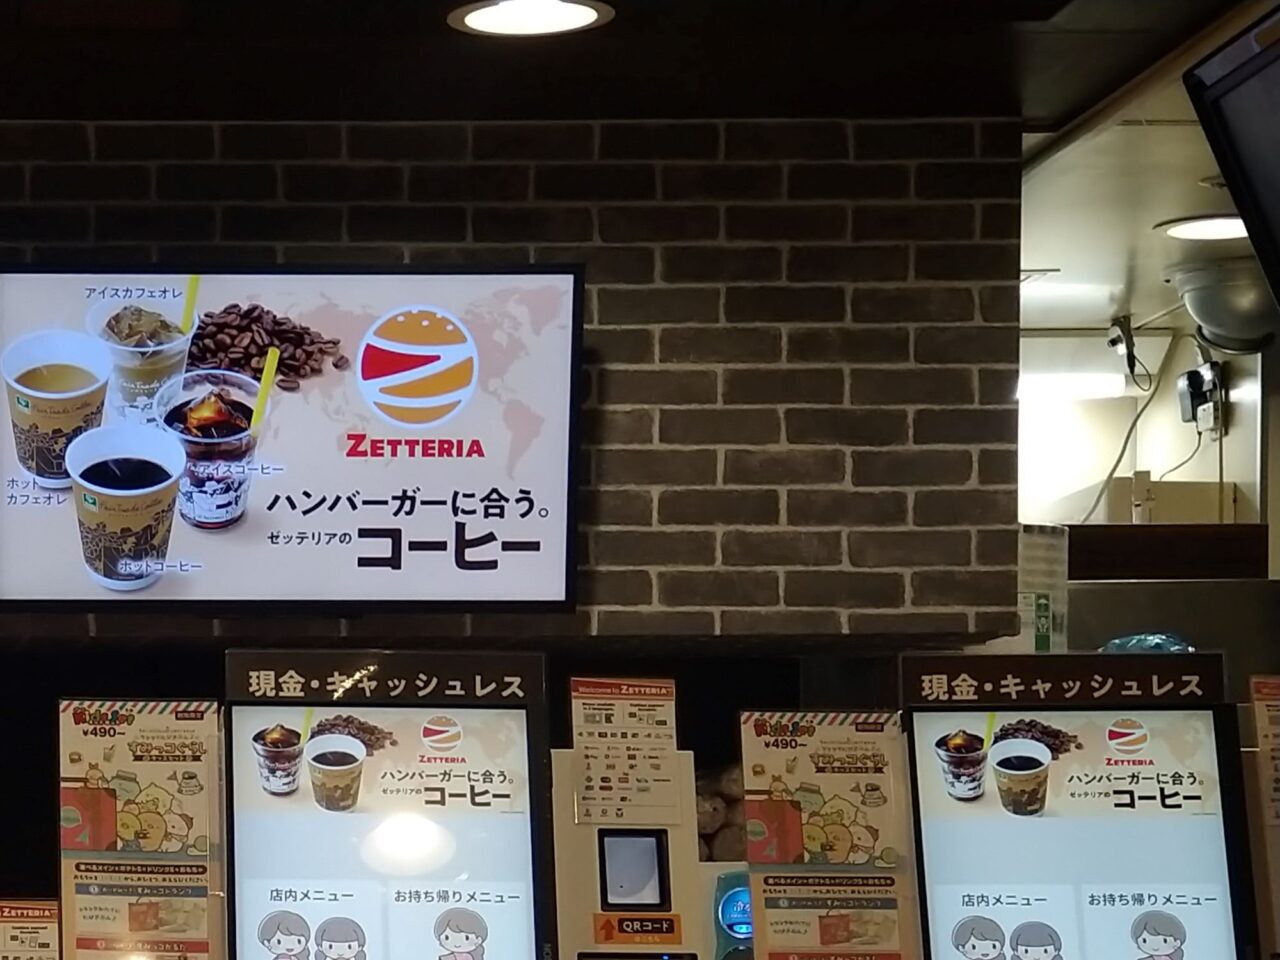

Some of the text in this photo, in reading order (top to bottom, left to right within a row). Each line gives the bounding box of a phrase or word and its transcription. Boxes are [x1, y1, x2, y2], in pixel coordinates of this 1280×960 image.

[84, 285, 183, 299] アイスカフェオレ
[345, 433, 485, 458] ZETTERIA
[198, 464, 284, 476] アイスコーヒー
[6, 477, 40, 490] ホット
[6, 493, 68, 505] カフェオレ
[267, 487, 551, 519] ハンバーガーに合う。
[267, 522, 541, 571] ゼッテリアの コーヒー
[119, 560, 203, 572] ホットコーヒー
[247, 669, 526, 698] 現金・キャッシュレス
[920, 673, 1204, 701] 現金・キャッシュレス
[418, 754, 467, 764] ZETTERIA
[1105, 757, 1155, 766] ZETTERIA
[381, 768, 514, 784] ハンバーガーに合う。
[1067, 770, 1205, 786] ハンバーガーに合う。
[423, 784, 512, 807] コーヒー
[1112, 785, 1202, 809] コーヒー
[269, 888, 354, 902] 店内メニュー
[394, 889, 521, 903] お持ち帰りメニュー
[961, 893, 1048, 908] 店内メニュー
[1088, 893, 1218, 907] お持ち帰りメニュー
[2, 907, 51, 917] ZETTERIA
[622, 920, 670, 932] QRコード
